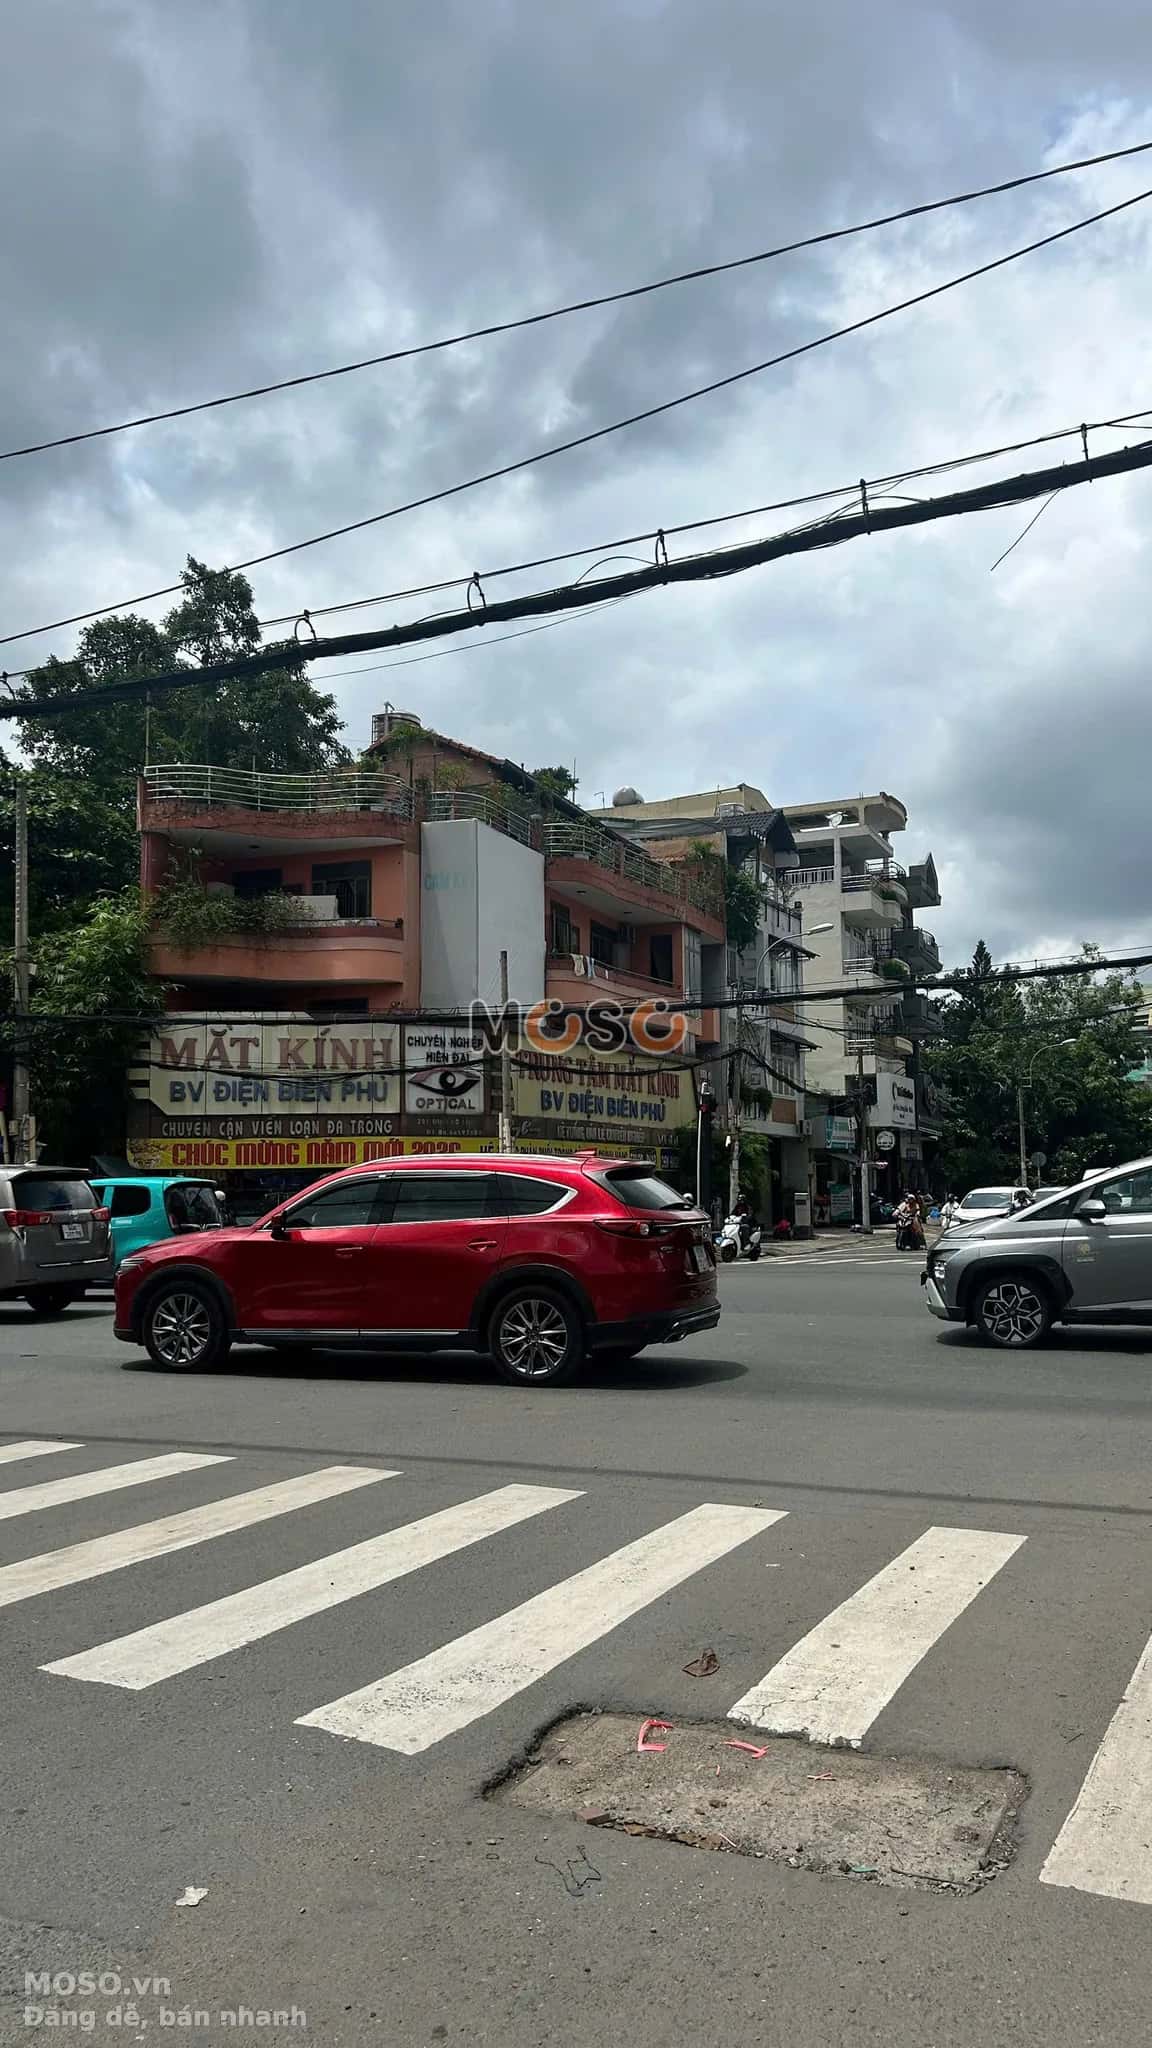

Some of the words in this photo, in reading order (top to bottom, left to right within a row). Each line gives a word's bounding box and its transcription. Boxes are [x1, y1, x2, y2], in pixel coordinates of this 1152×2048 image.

[277, 1027, 394, 1070] KÍNH
[169, 1080, 205, 1102] BV
[213, 1078, 268, 1107] ĐIỆN
[341, 1076, 388, 1102] PHỦ
[648, 1063, 680, 1099] KÍNH
[416, 1097, 476, 1110] OPTICAL
[541, 1089, 564, 1111] BV
[568, 1089, 604, 1119] ĐIỆN
[607, 1094, 639, 1119] BIÊN
[640, 1098, 666, 1122] PHỦ
[290, 1119, 320, 1138] LOẠN
[327, 1120, 343, 1135] ĐA
[172, 1140, 229, 1166] CHÚC
[307, 1139, 356, 1165] NĂM
